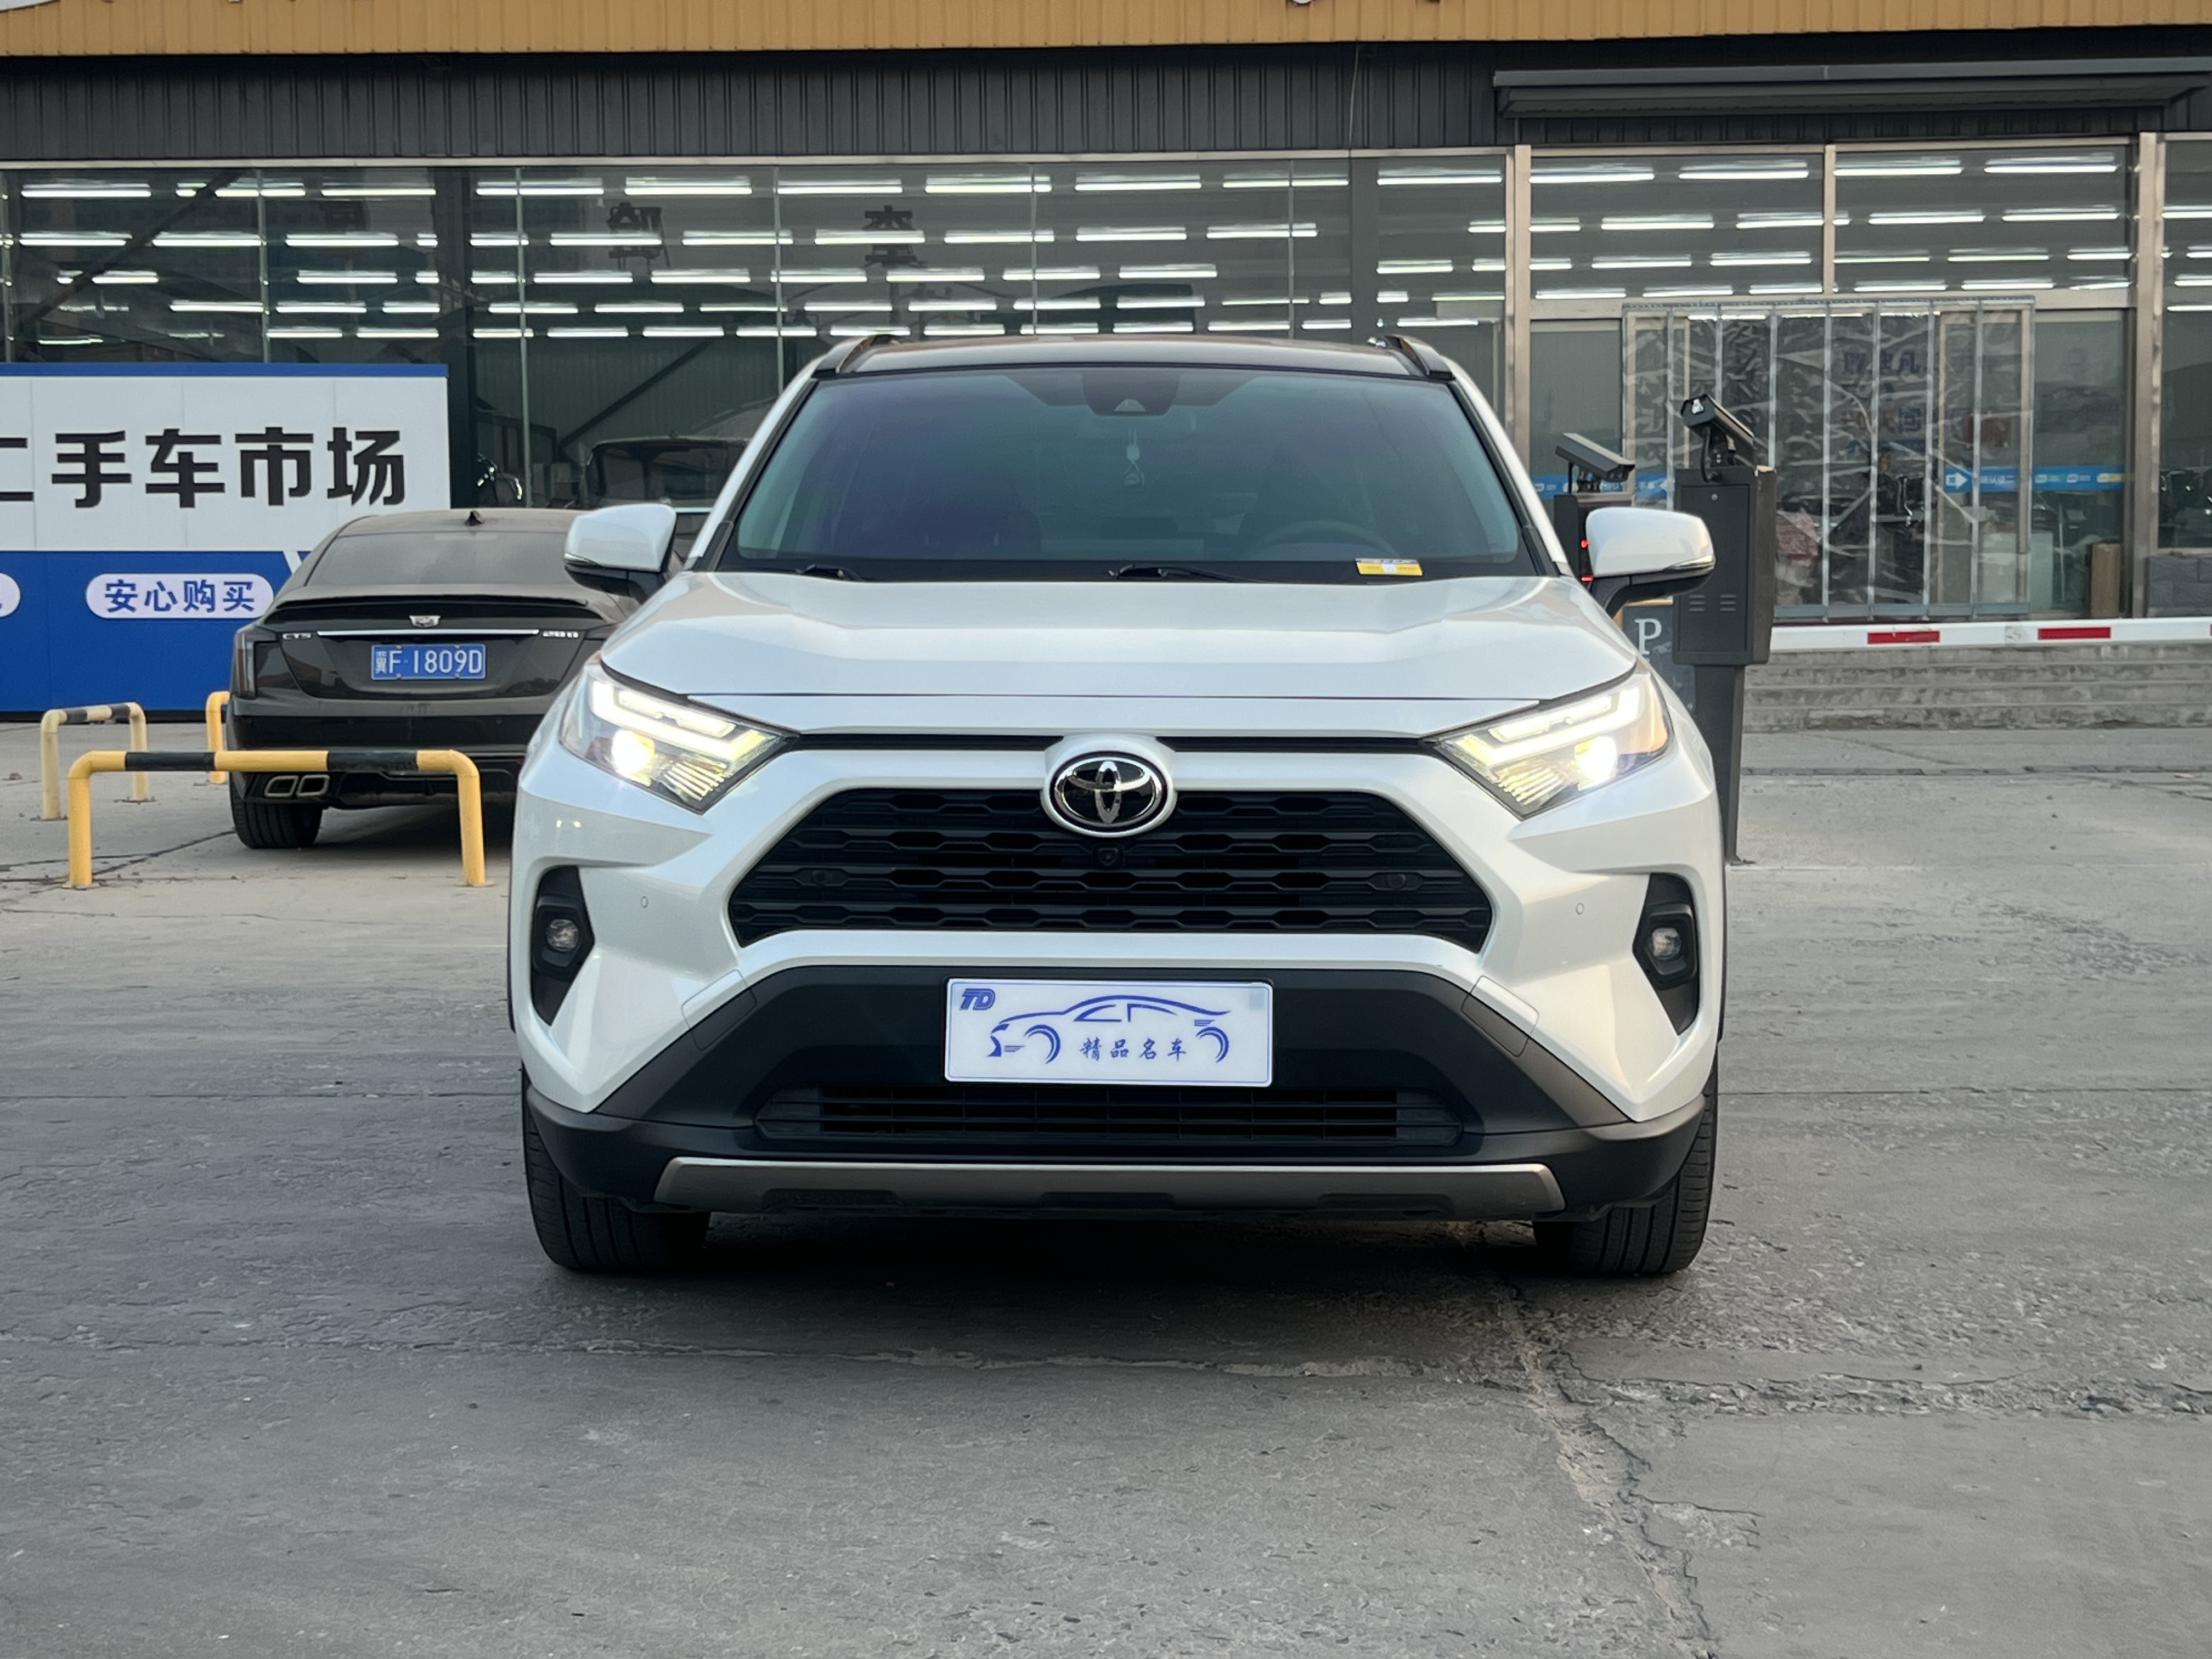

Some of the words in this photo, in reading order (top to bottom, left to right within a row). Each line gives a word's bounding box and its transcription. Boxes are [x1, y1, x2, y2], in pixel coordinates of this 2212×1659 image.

[105, 579, 255, 613] 安心购买
[1634, 618, 1662, 655] P
[1080, 1037, 1186, 1062] 精品名车
